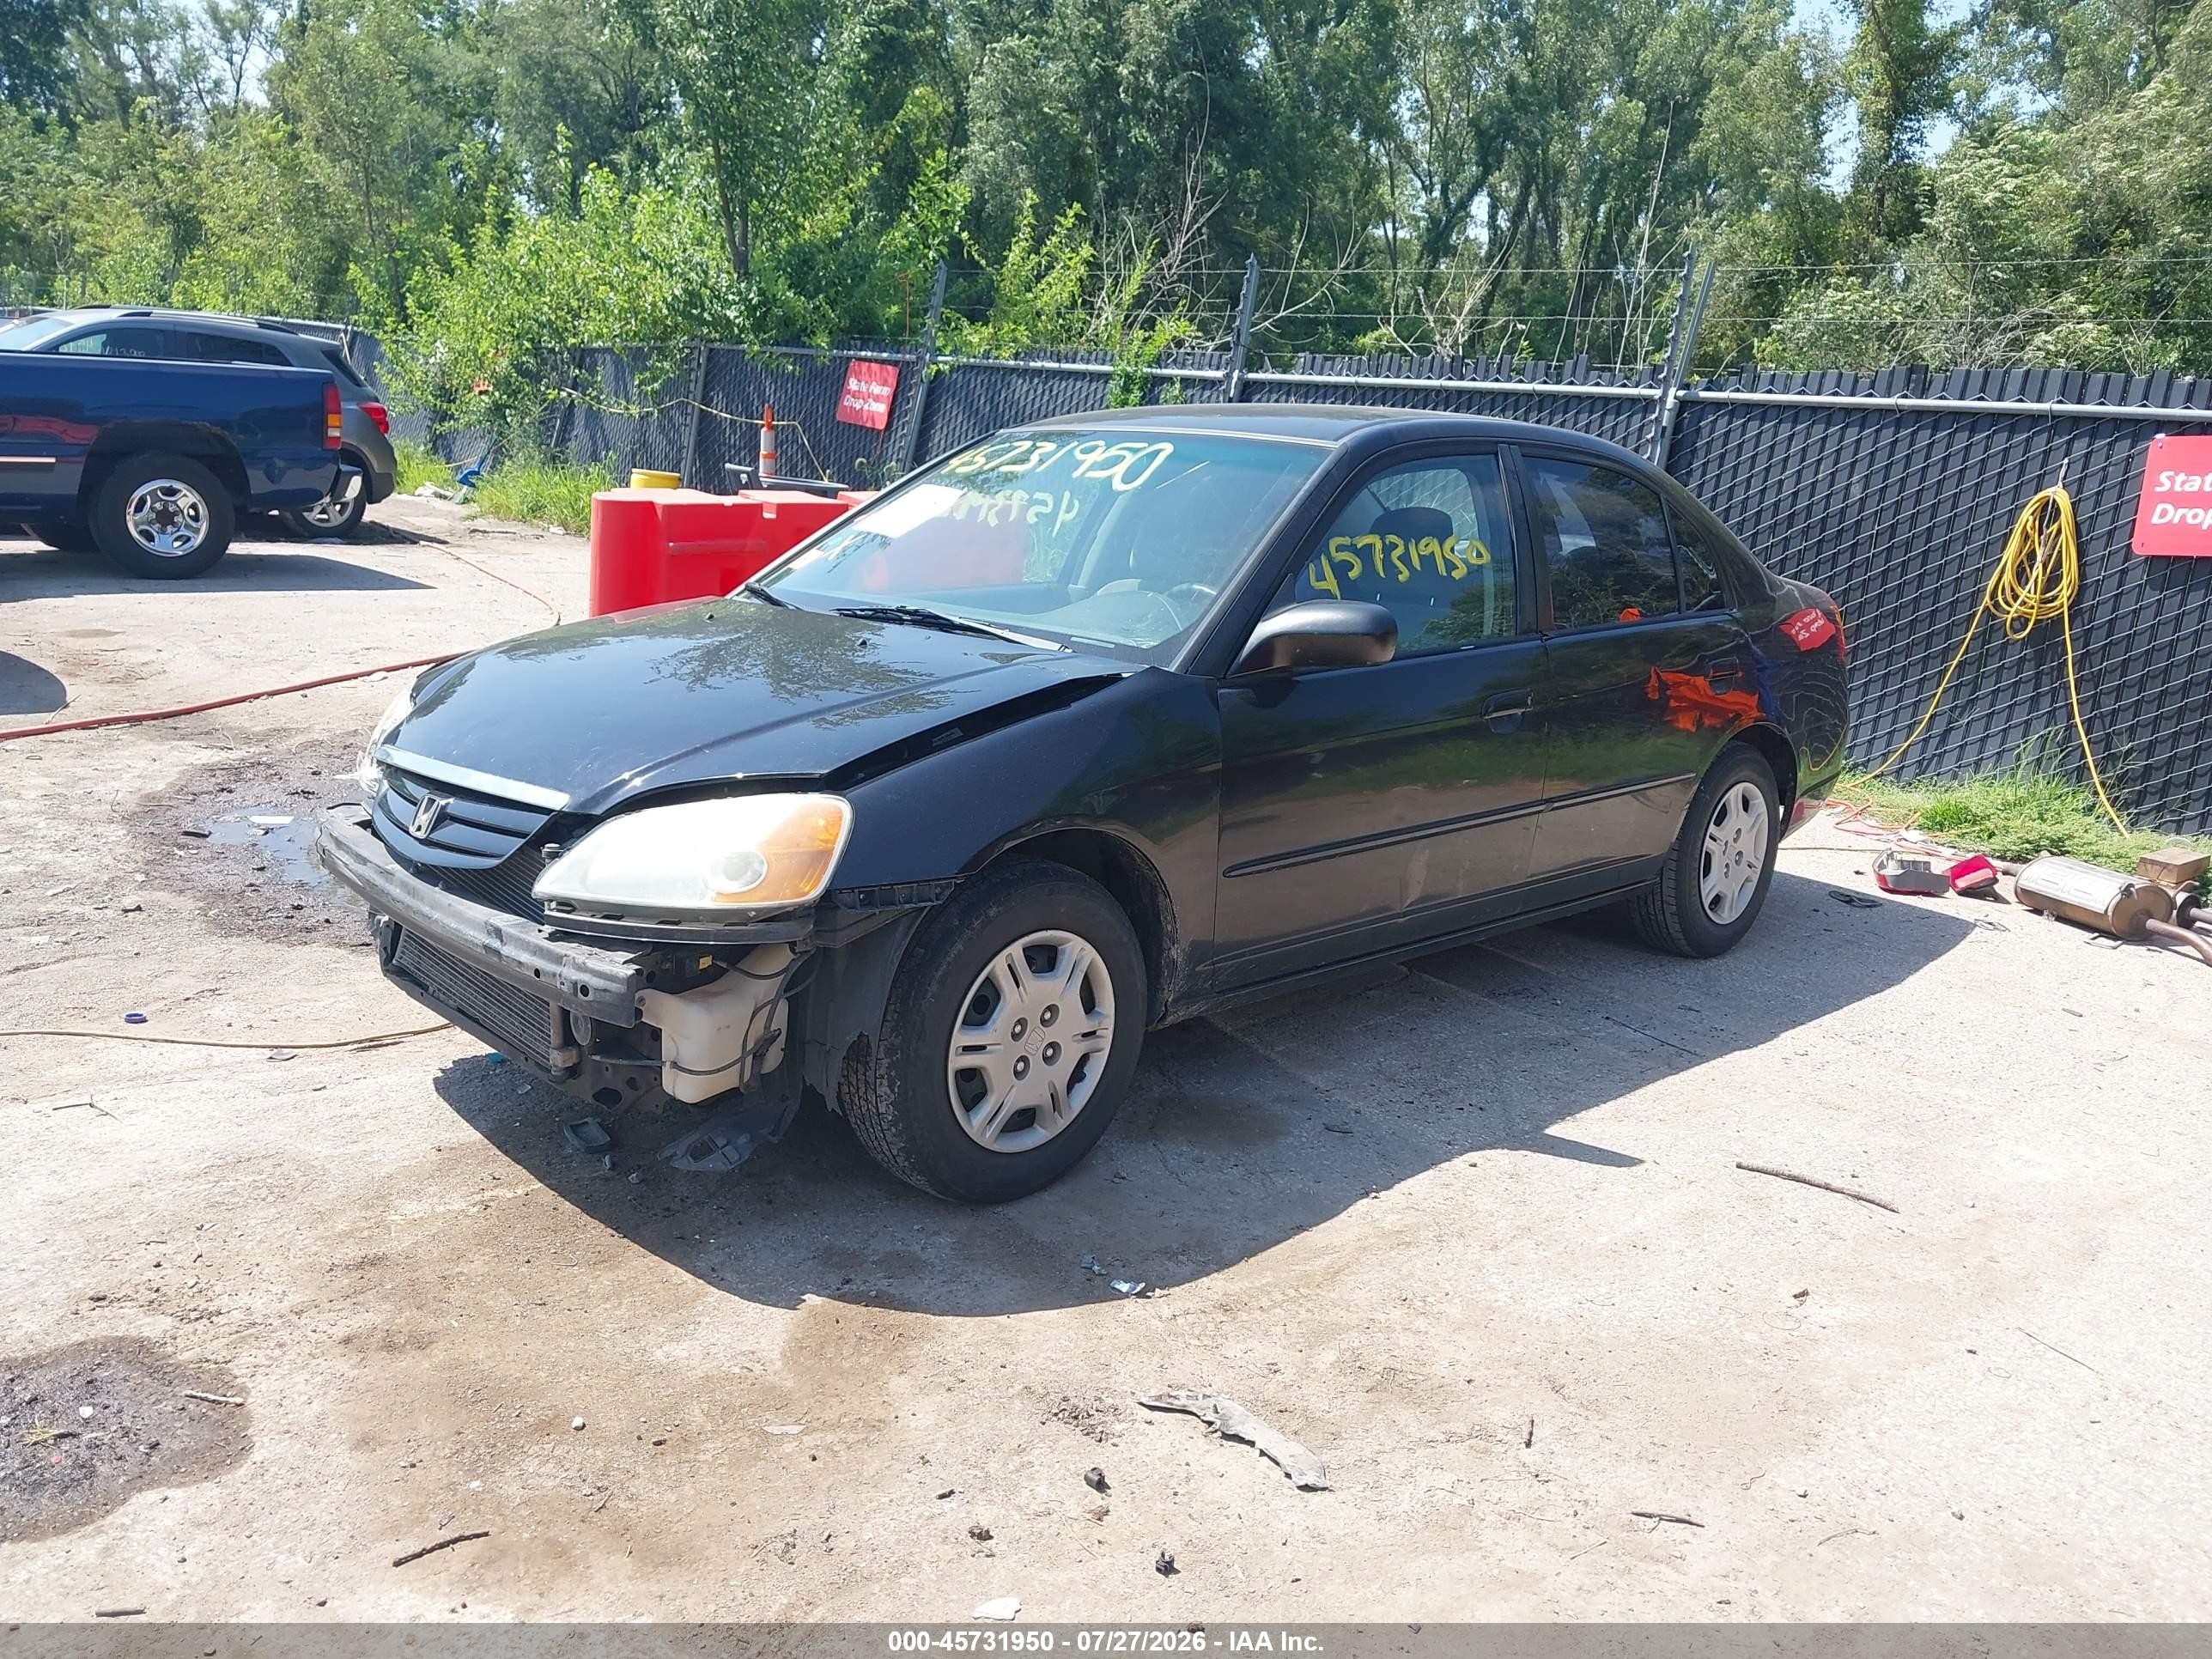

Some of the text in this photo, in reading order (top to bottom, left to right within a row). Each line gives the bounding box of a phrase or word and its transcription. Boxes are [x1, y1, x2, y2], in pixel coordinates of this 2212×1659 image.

[843, 395, 863, 410] Drop
[941, 440, 1174, 491] 45731950
[2154, 471, 2212, 492] Stat
[1309, 534, 1492, 600] 45731950
